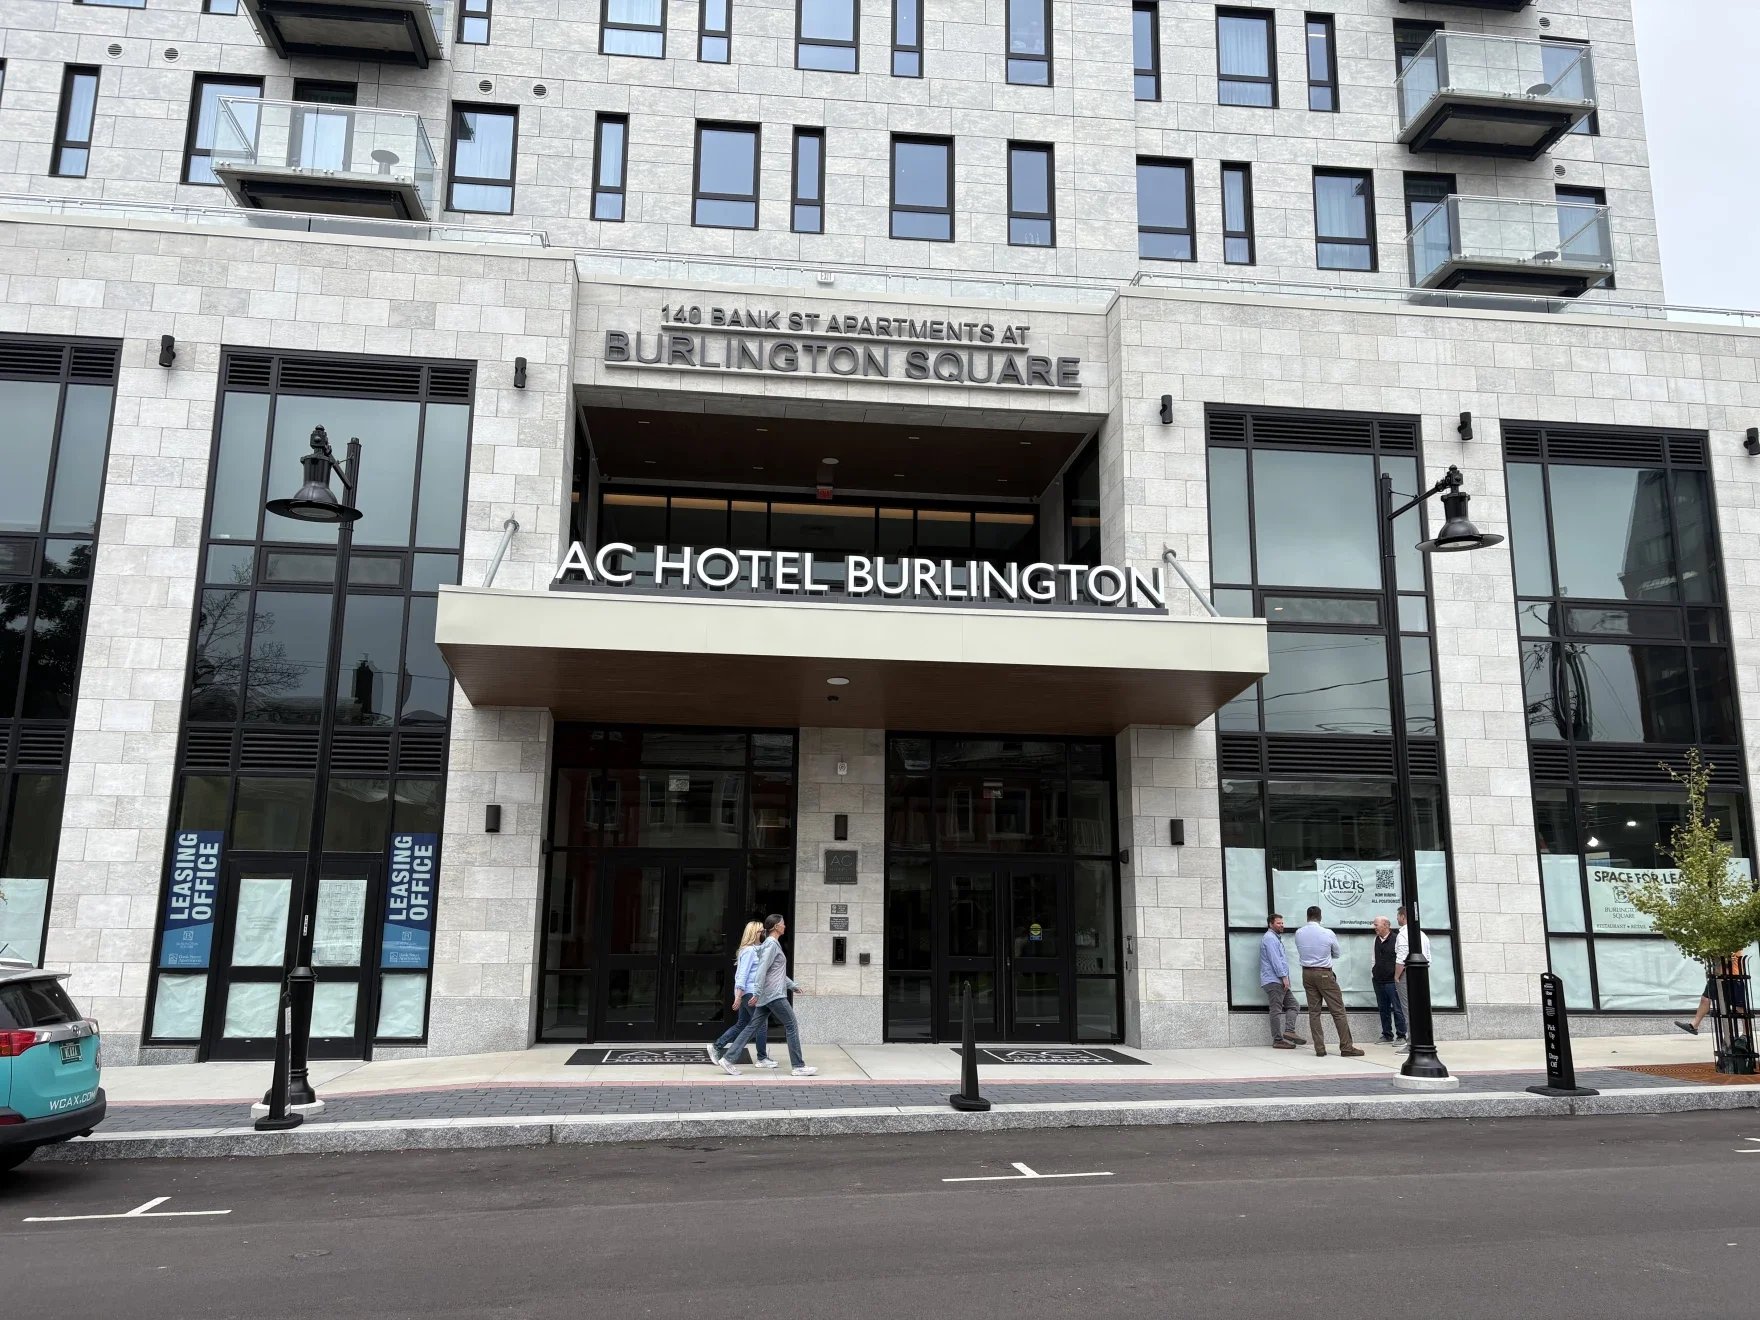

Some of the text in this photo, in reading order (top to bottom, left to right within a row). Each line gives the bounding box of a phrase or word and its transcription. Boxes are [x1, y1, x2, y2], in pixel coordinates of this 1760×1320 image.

[661, 304, 1031, 345] 140 BANK ST APARTMENTS AT
[604, 330, 1083, 388] BURLINGTON SQUARE
[554, 541, 1166, 609] AC HOTEL BURLINGTON
[169, 833, 198, 920] LEASING
[191, 842, 219, 921] OFFICE
[388, 836, 413, 921] LEASING
[409, 845, 433, 921] OFFICE
[830, 855, 853, 867] AC
[1320, 875, 1365, 893] jitters
[1594, 870, 1633, 883] SPACE
[1636, 872, 1659, 884] FOR
[1549, 1032, 1556, 1040] Up
[1549, 1053, 1559, 1061] Drop
